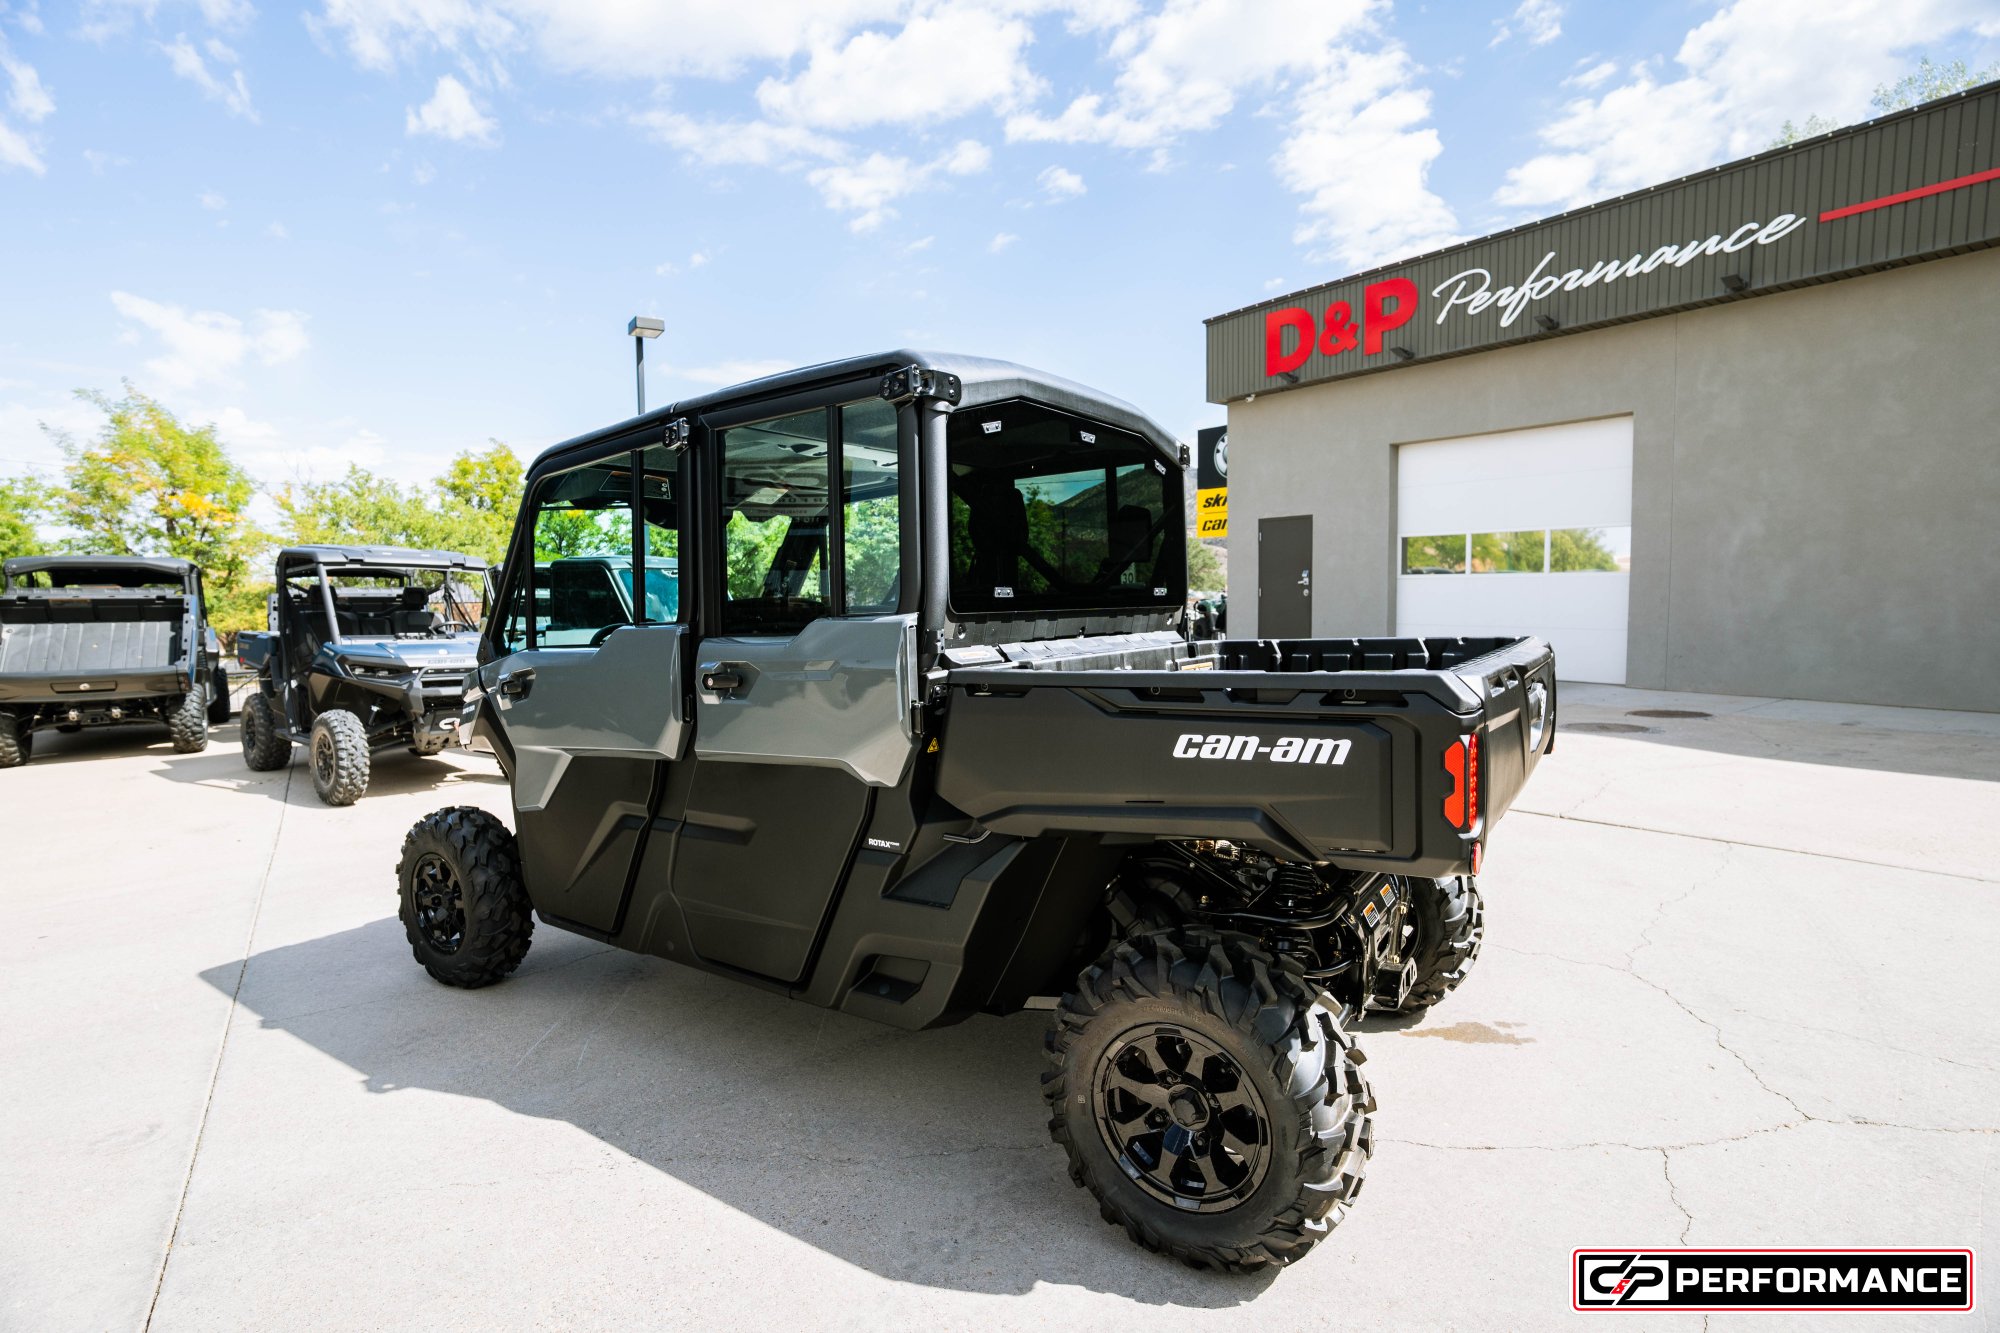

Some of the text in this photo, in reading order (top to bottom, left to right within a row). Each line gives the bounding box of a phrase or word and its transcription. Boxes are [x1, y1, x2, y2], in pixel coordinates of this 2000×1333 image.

[1266, 214, 1806, 376] D&P Performance
[1172, 733, 1352, 766] can-am
[868, 837, 891, 849] ROTAX
